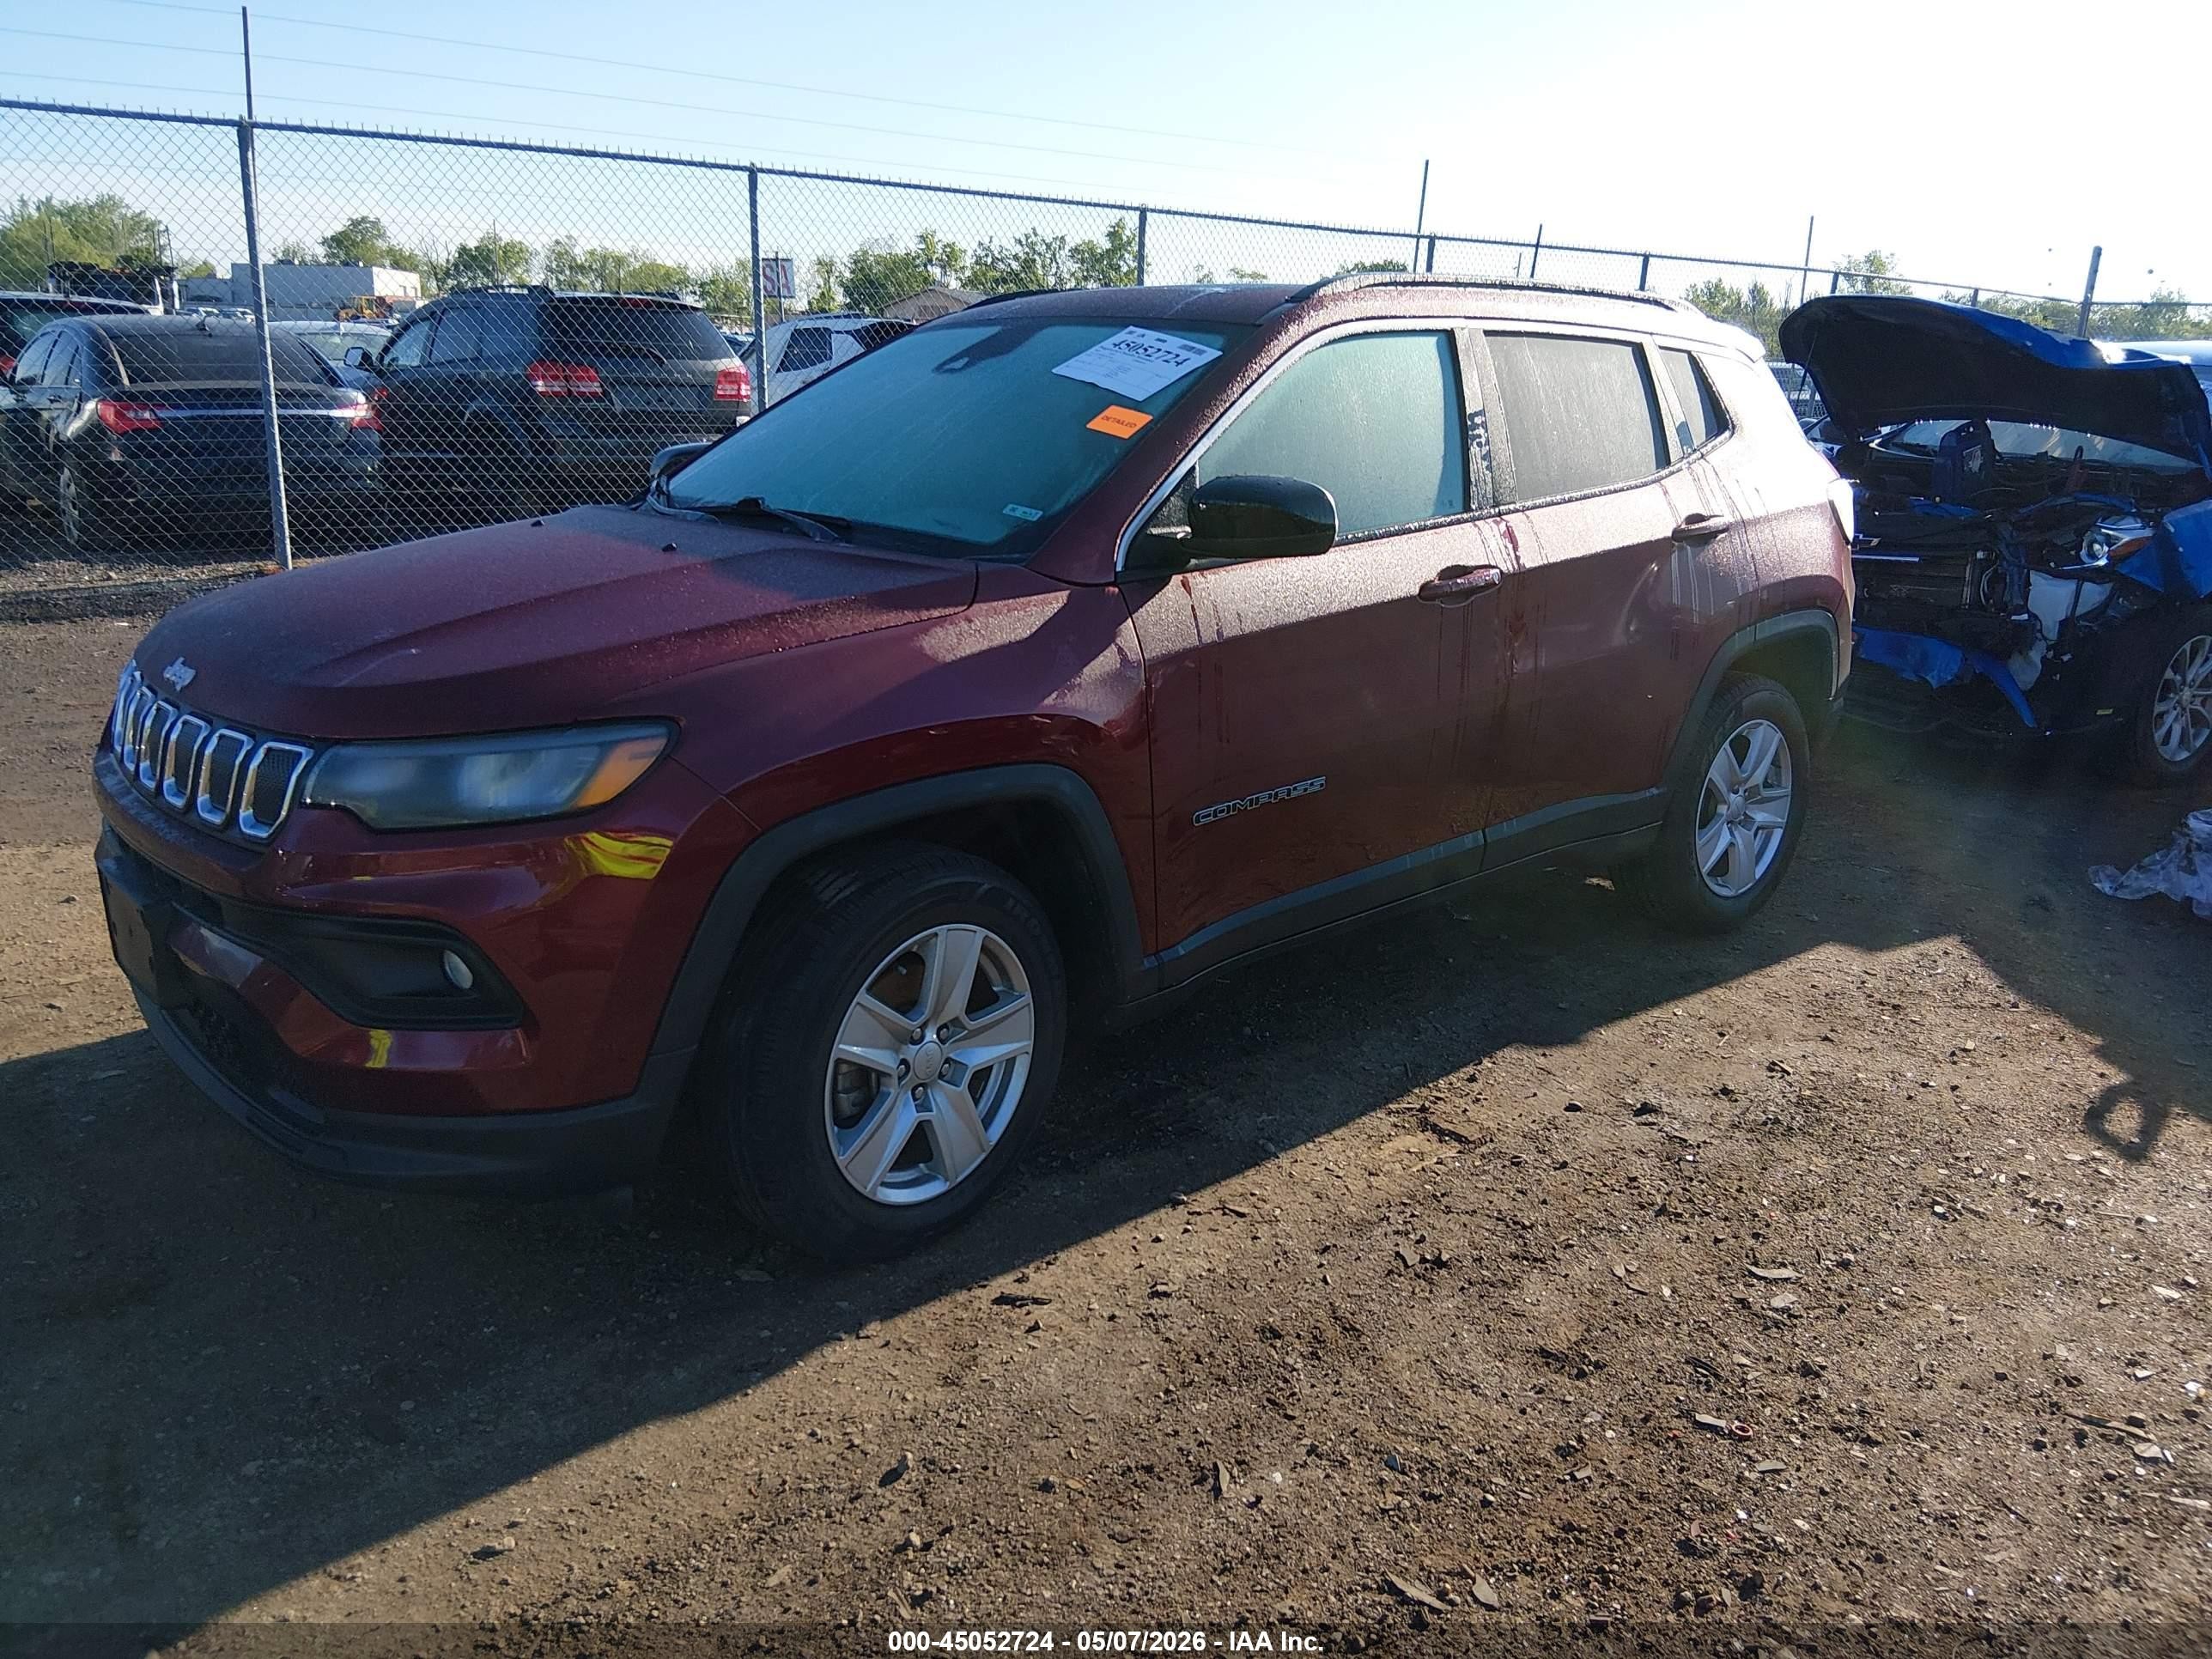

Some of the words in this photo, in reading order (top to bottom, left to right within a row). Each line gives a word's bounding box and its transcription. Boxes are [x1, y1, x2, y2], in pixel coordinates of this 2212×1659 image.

[1112, 339, 1191, 368] 45052724
[1101, 414, 1138, 428] DETAILED
[1192, 775, 1327, 827] COMPASS
